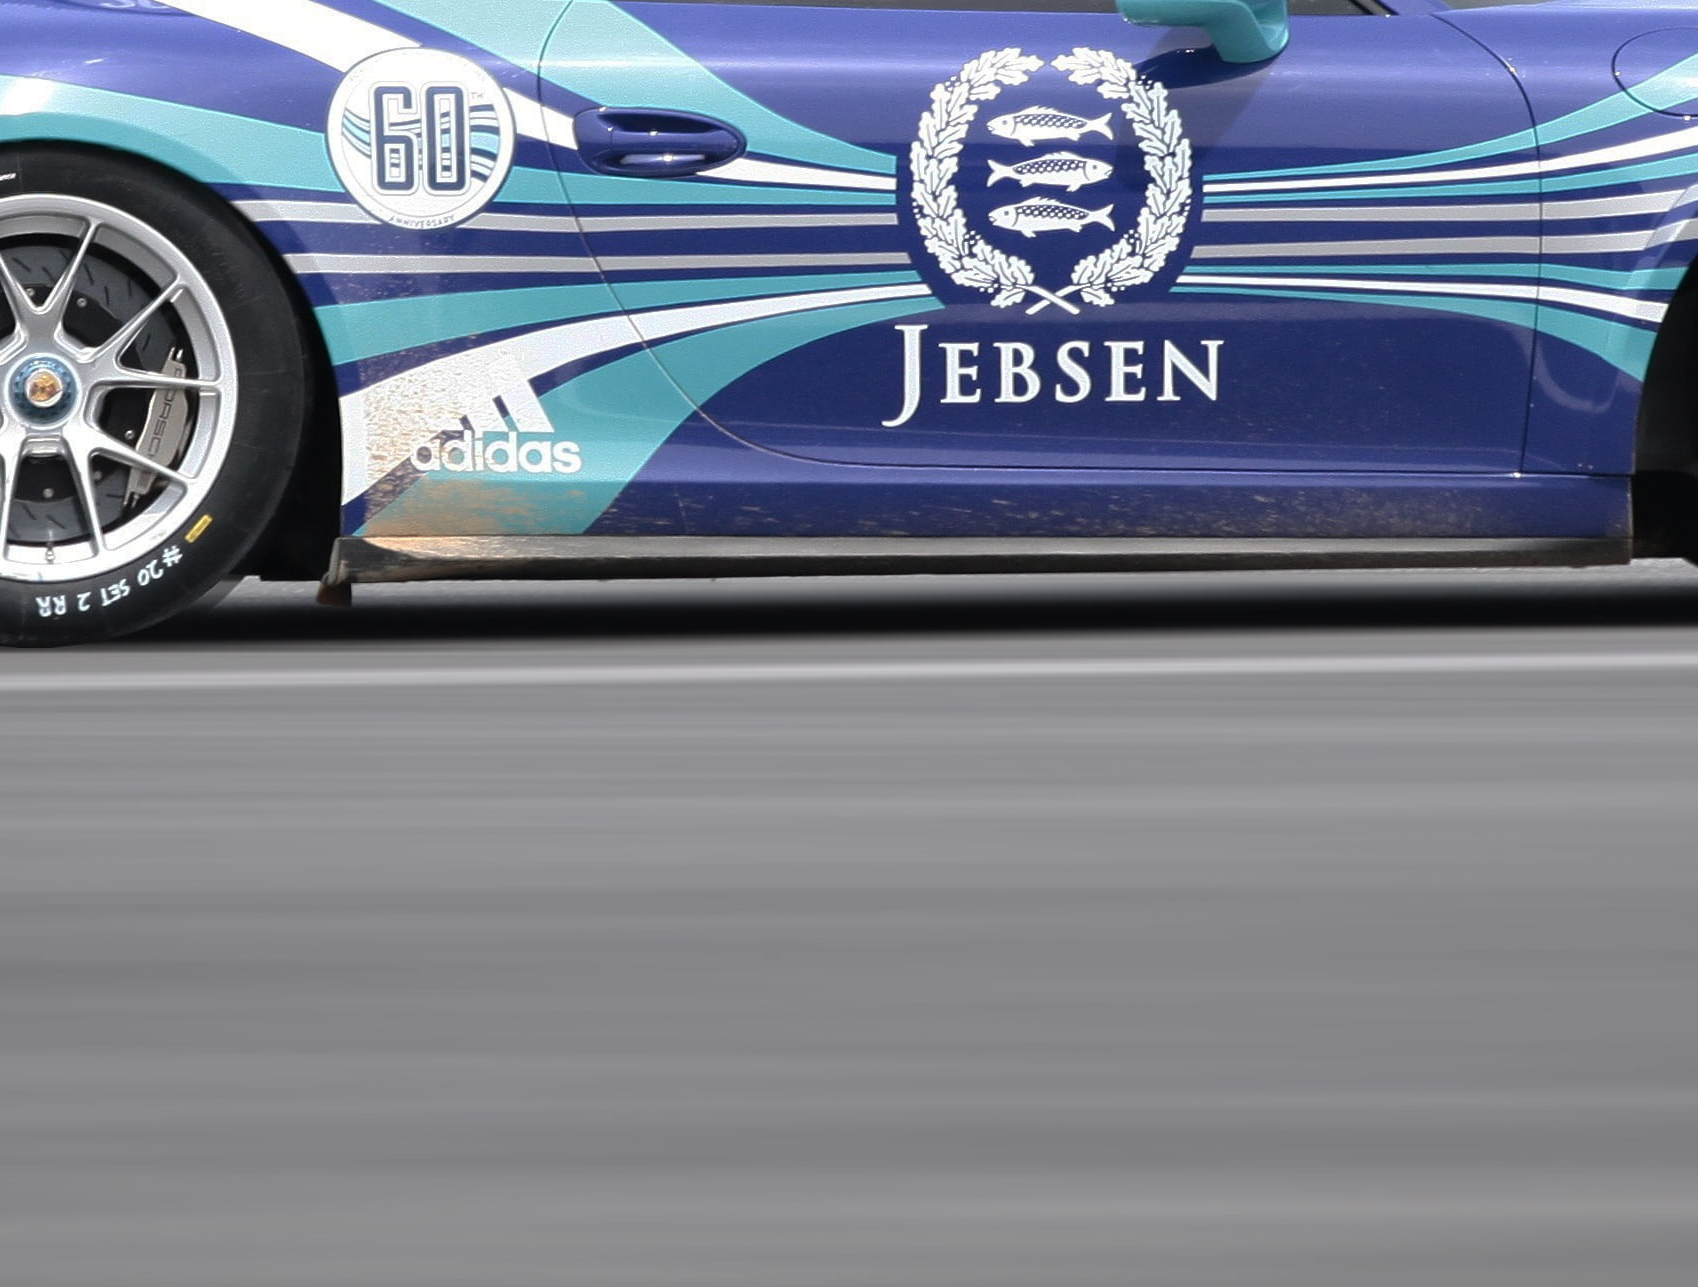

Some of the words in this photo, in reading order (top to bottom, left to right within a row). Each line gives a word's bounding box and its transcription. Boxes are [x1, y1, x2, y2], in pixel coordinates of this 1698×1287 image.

[370, 83, 470, 194] 60
[409, 429, 582, 474] adidas
[76, 591, 92, 612] 2
[100, 578, 131, 607] SET
